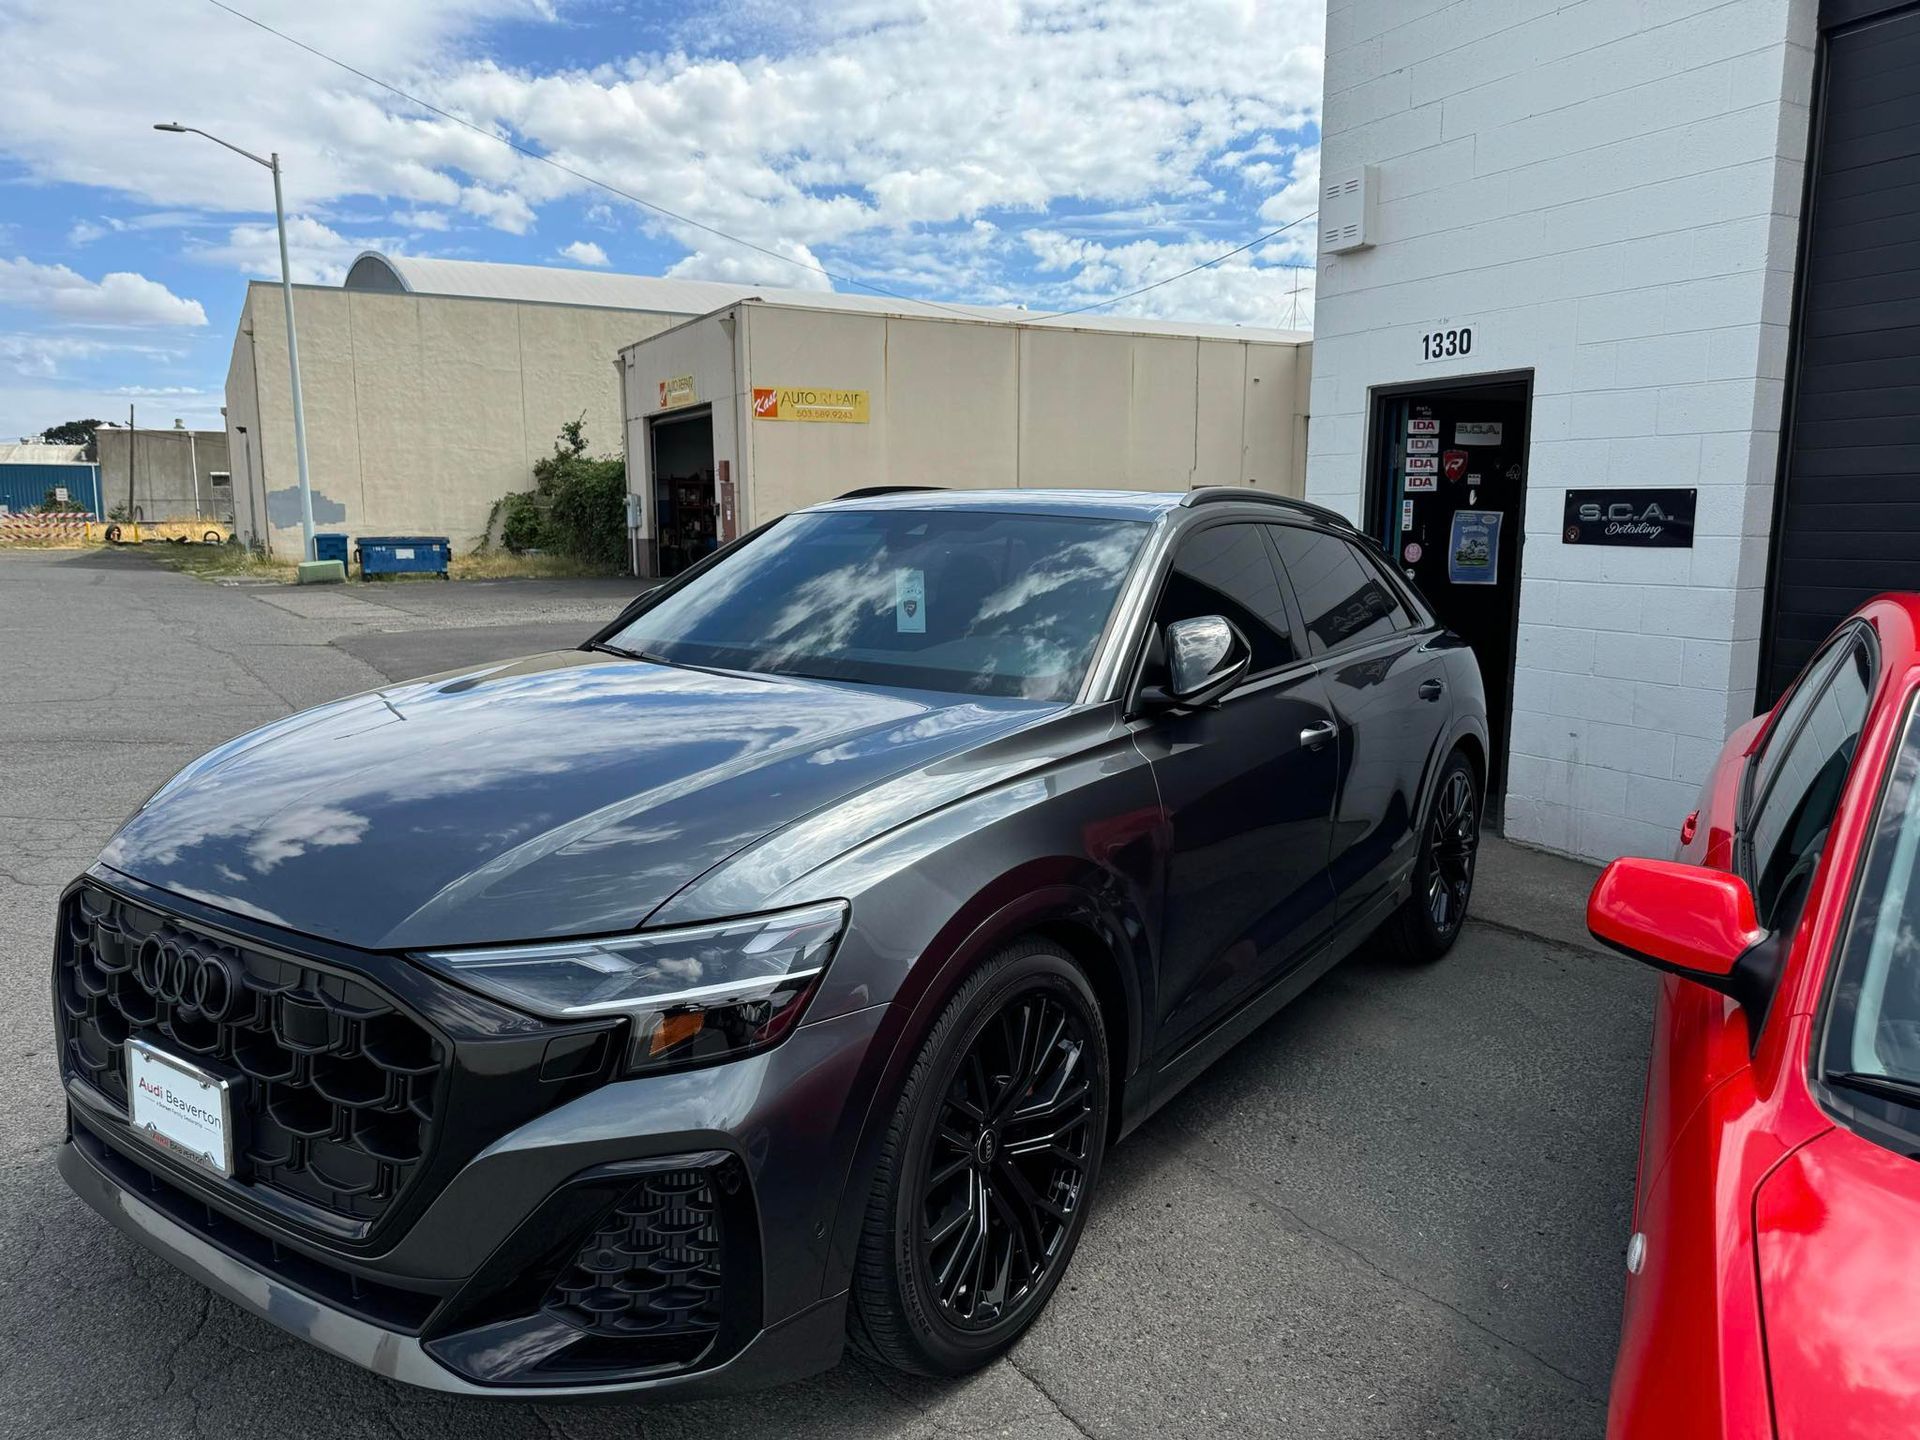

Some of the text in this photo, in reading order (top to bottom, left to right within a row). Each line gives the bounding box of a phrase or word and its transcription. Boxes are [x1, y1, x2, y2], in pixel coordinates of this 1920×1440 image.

[1422, 328, 1471, 360] 1330
[780, 391, 817, 408] AUTO
[1413, 421, 1435, 430] IDA
[1411, 440, 1435, 449] IDA
[1409, 459, 1434, 468] IDA
[1408, 478, 1433, 487] IDA
[1579, 503, 1674, 521] S.C.A.
[1604, 521, 1664, 539] Detailing
[139, 1077, 222, 1129] Audi Beaverton
